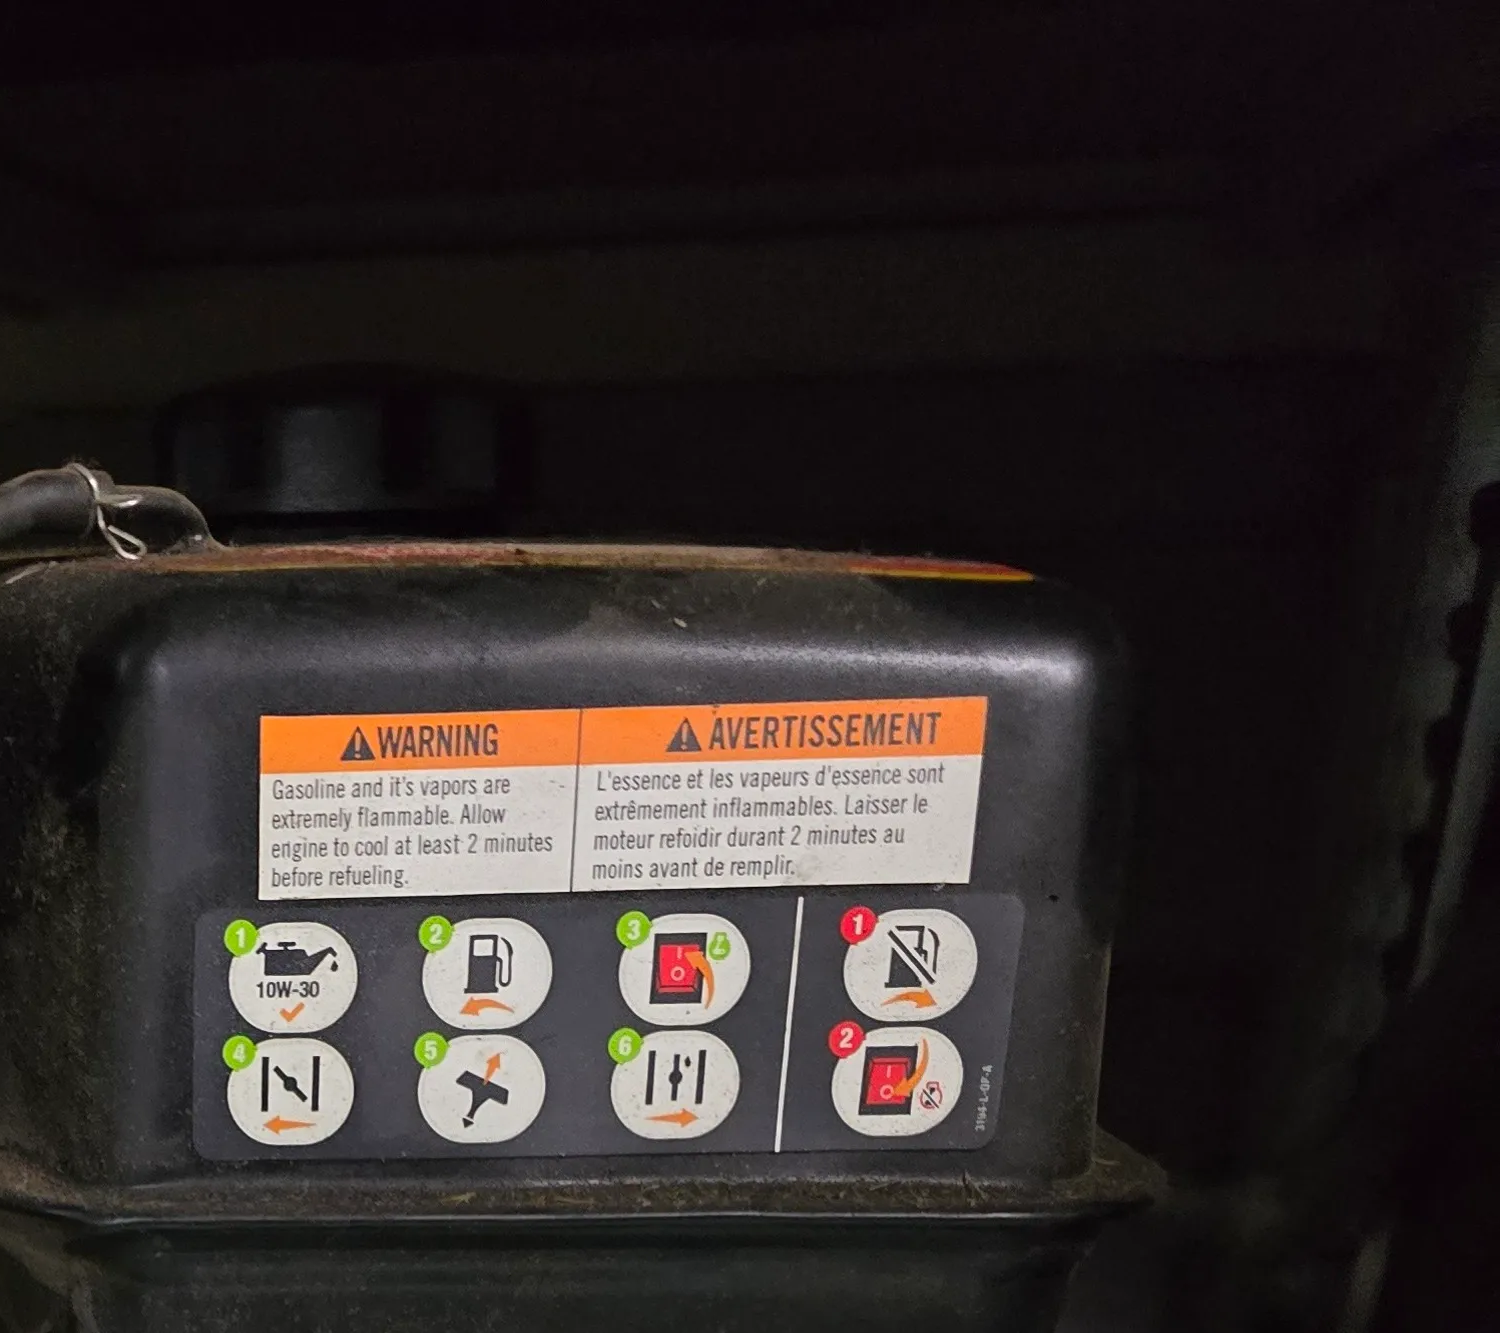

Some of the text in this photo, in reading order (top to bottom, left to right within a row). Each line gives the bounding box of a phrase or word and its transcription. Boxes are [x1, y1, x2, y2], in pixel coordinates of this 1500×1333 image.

[377, 723, 499, 758] WARNING
[708, 712, 942, 751] AVERTISSEMENT
[272, 777, 511, 801] Gasoline and it's vapors are
[596, 763, 946, 793] L'essence et les vapeurs d'essence sont
[271, 804, 507, 832] extremely flammable. Allow
[594, 793, 928, 822] extrêmement inflammables. Laisser le
[271, 832, 553, 862] engine to cool at least 2 minutes
[593, 824, 905, 851] moteur refoidir durant 2 minutes au
[271, 866, 409, 889] before refueling.
[592, 854, 796, 881] moins avant de remplir.
[429, 923, 444, 944] 2
[627, 918, 641, 940] 3
[852, 914, 864, 936] 1
[235, 928, 246, 949] 1
[256, 981, 320, 999] 10W-30
[618, 1034, 632, 1055] 6
[839, 1027, 854, 1049] 2
[232, 1042, 247, 1063] 4
[423, 1040, 439, 1061] 5
